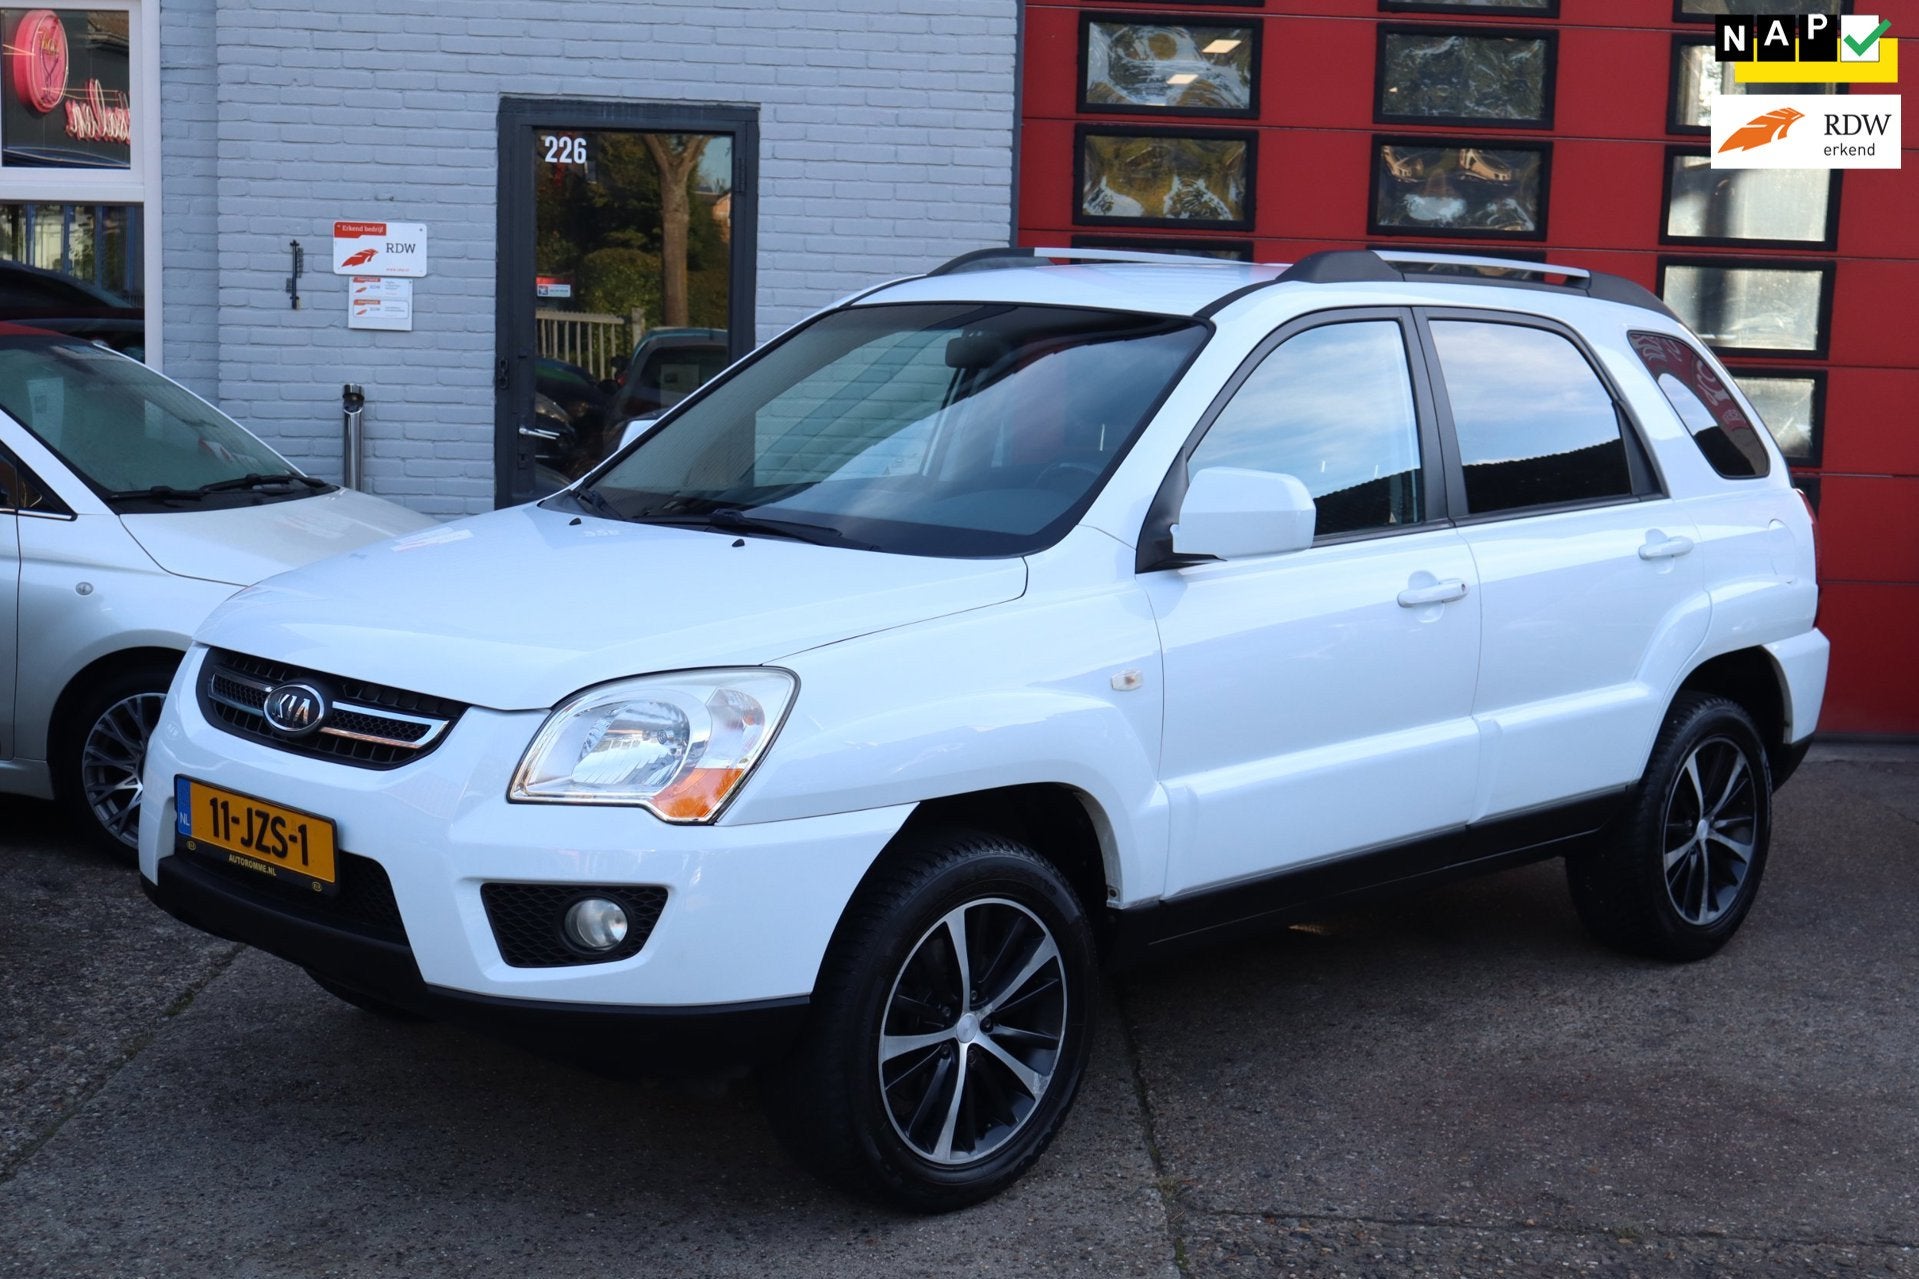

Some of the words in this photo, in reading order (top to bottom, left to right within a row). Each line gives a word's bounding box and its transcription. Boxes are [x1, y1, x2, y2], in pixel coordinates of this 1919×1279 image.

[544, 135, 587, 164] 226
[385, 242, 416, 254] RDW
[271, 692, 311, 726] KIA
[179, 812, 191, 827] NL
[209, 796, 310, 867] 11-JZS-1
